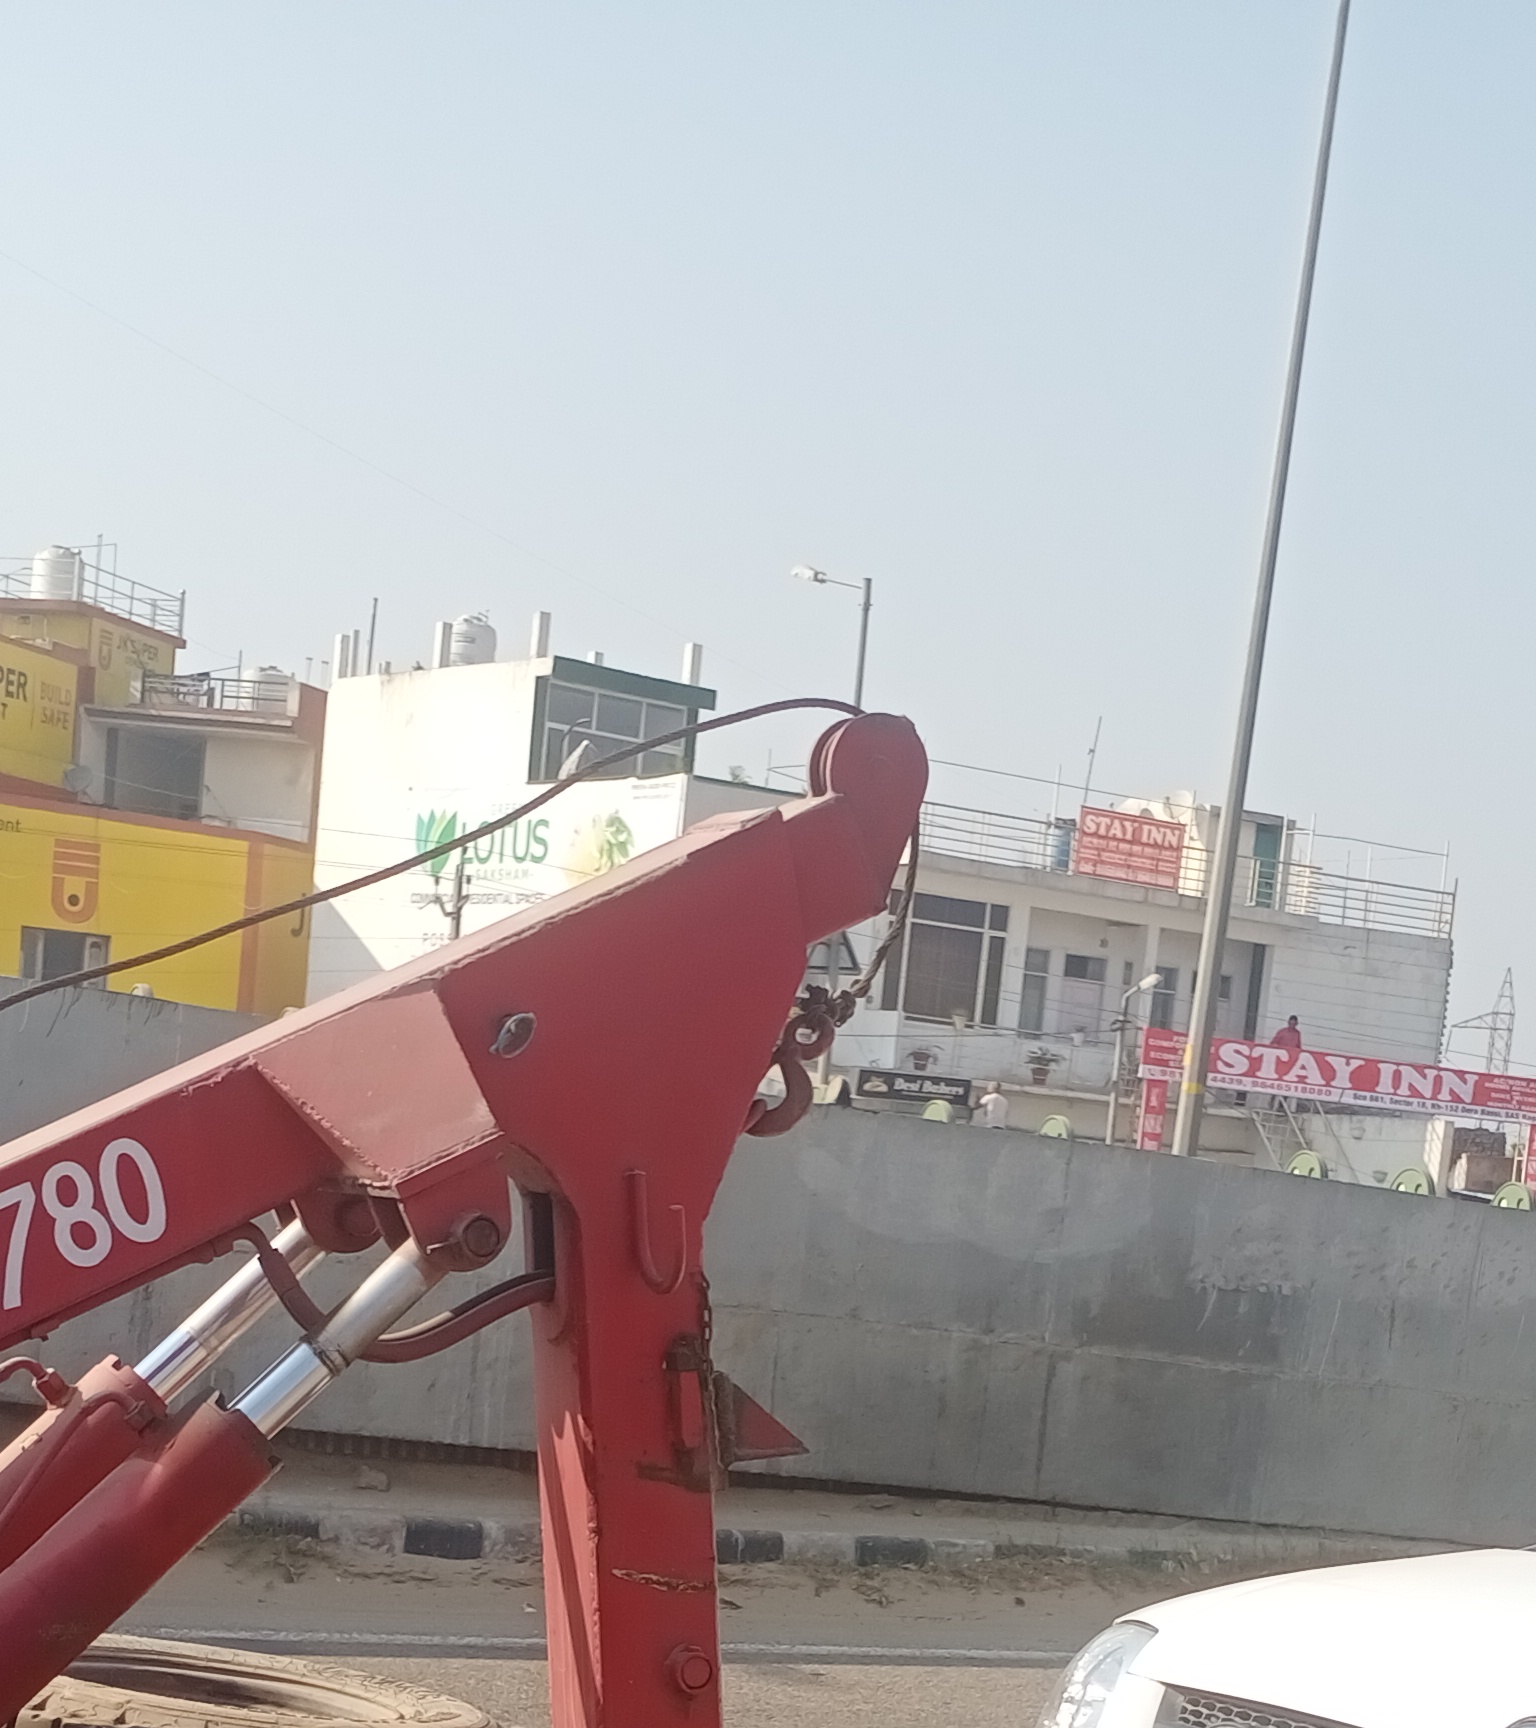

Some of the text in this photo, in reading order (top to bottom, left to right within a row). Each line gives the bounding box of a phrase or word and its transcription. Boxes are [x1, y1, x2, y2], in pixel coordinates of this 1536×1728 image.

[462, 818, 550, 865] LOTUS
[1083, 814, 1139, 841] STAY
[1140, 824, 1180, 849] INN
[1216, 1042, 1479, 1104] STAY INN
